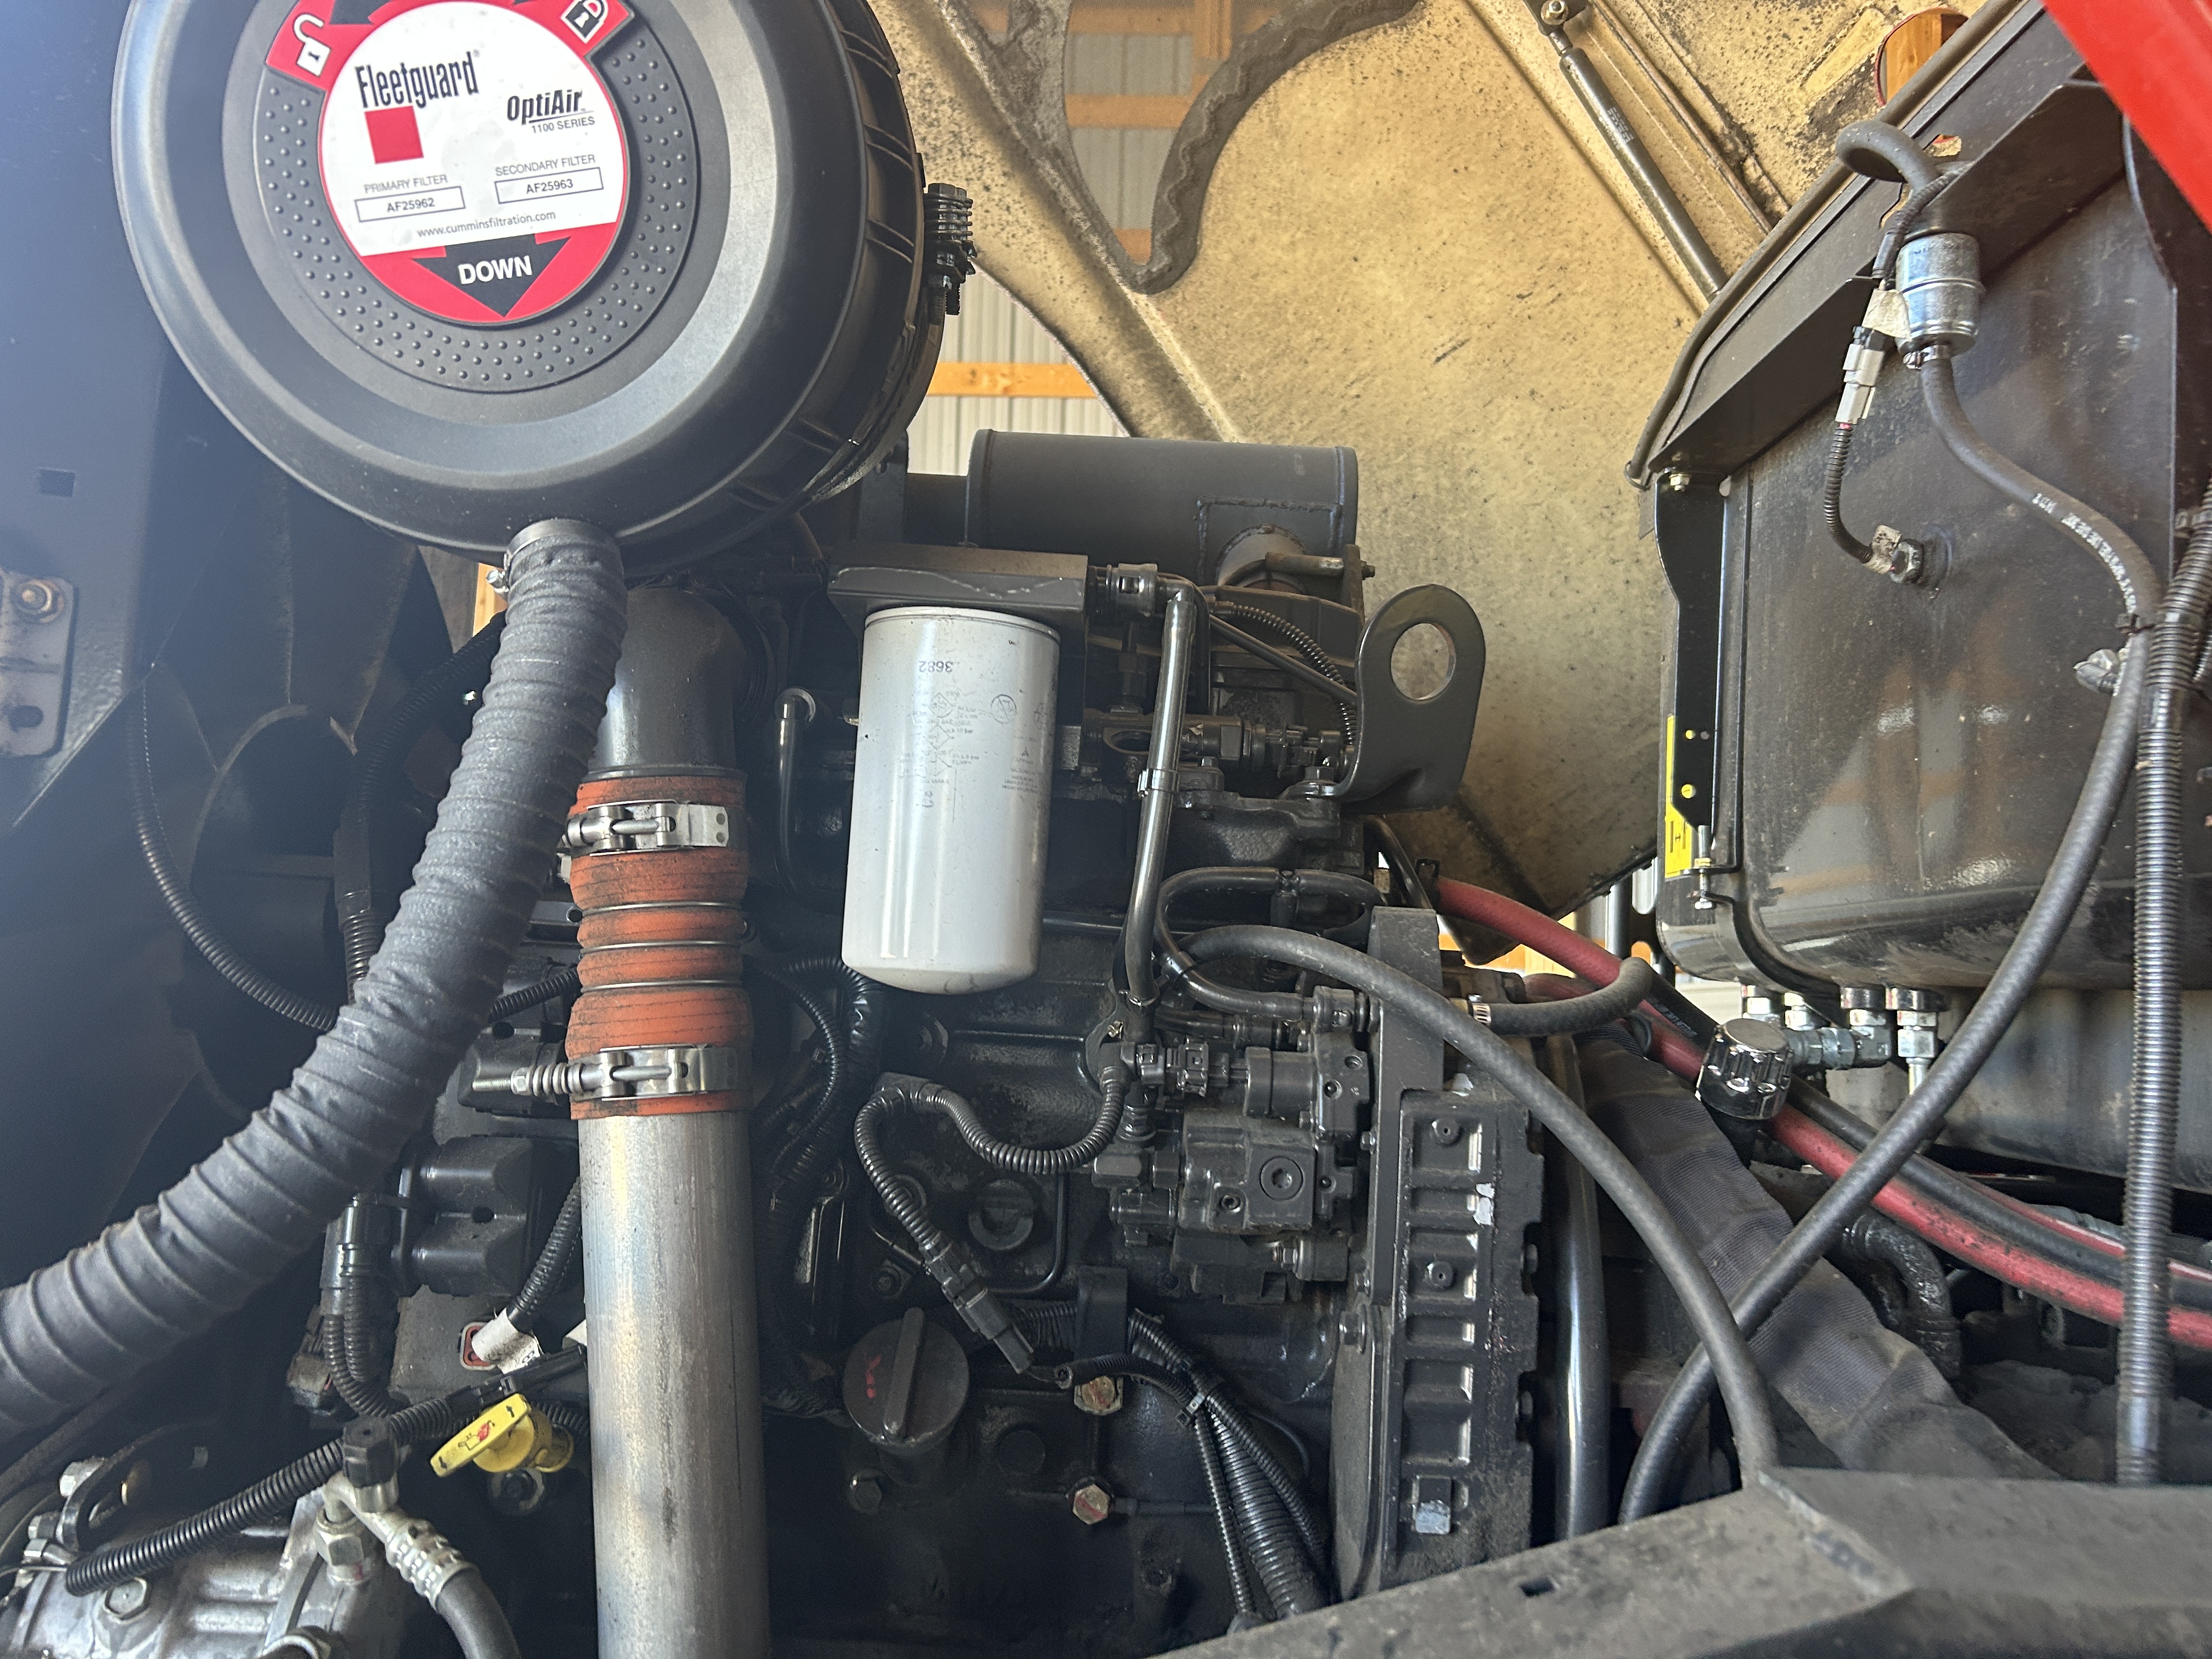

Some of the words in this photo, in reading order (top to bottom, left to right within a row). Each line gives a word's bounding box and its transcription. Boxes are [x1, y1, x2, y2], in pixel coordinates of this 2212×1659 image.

[354, 51, 479, 109] Fleetguard
[507, 89, 583, 125] OptiAir
[531, 122, 555, 134] 1100
[557, 116, 595, 130] SERIES
[495, 159, 558, 176] SECONDARY
[561, 154, 596, 167] FILTER
[364, 178, 410, 194] PRIMARY
[413, 174, 448, 188] FILTER
[526, 179, 573, 195] AF25963
[387, 198, 435, 213] AF25962
[417, 212, 556, 238] www.cumminsfiltration.com
[458, 255, 532, 285] DOWN
[919, 661, 954, 673] 3682
